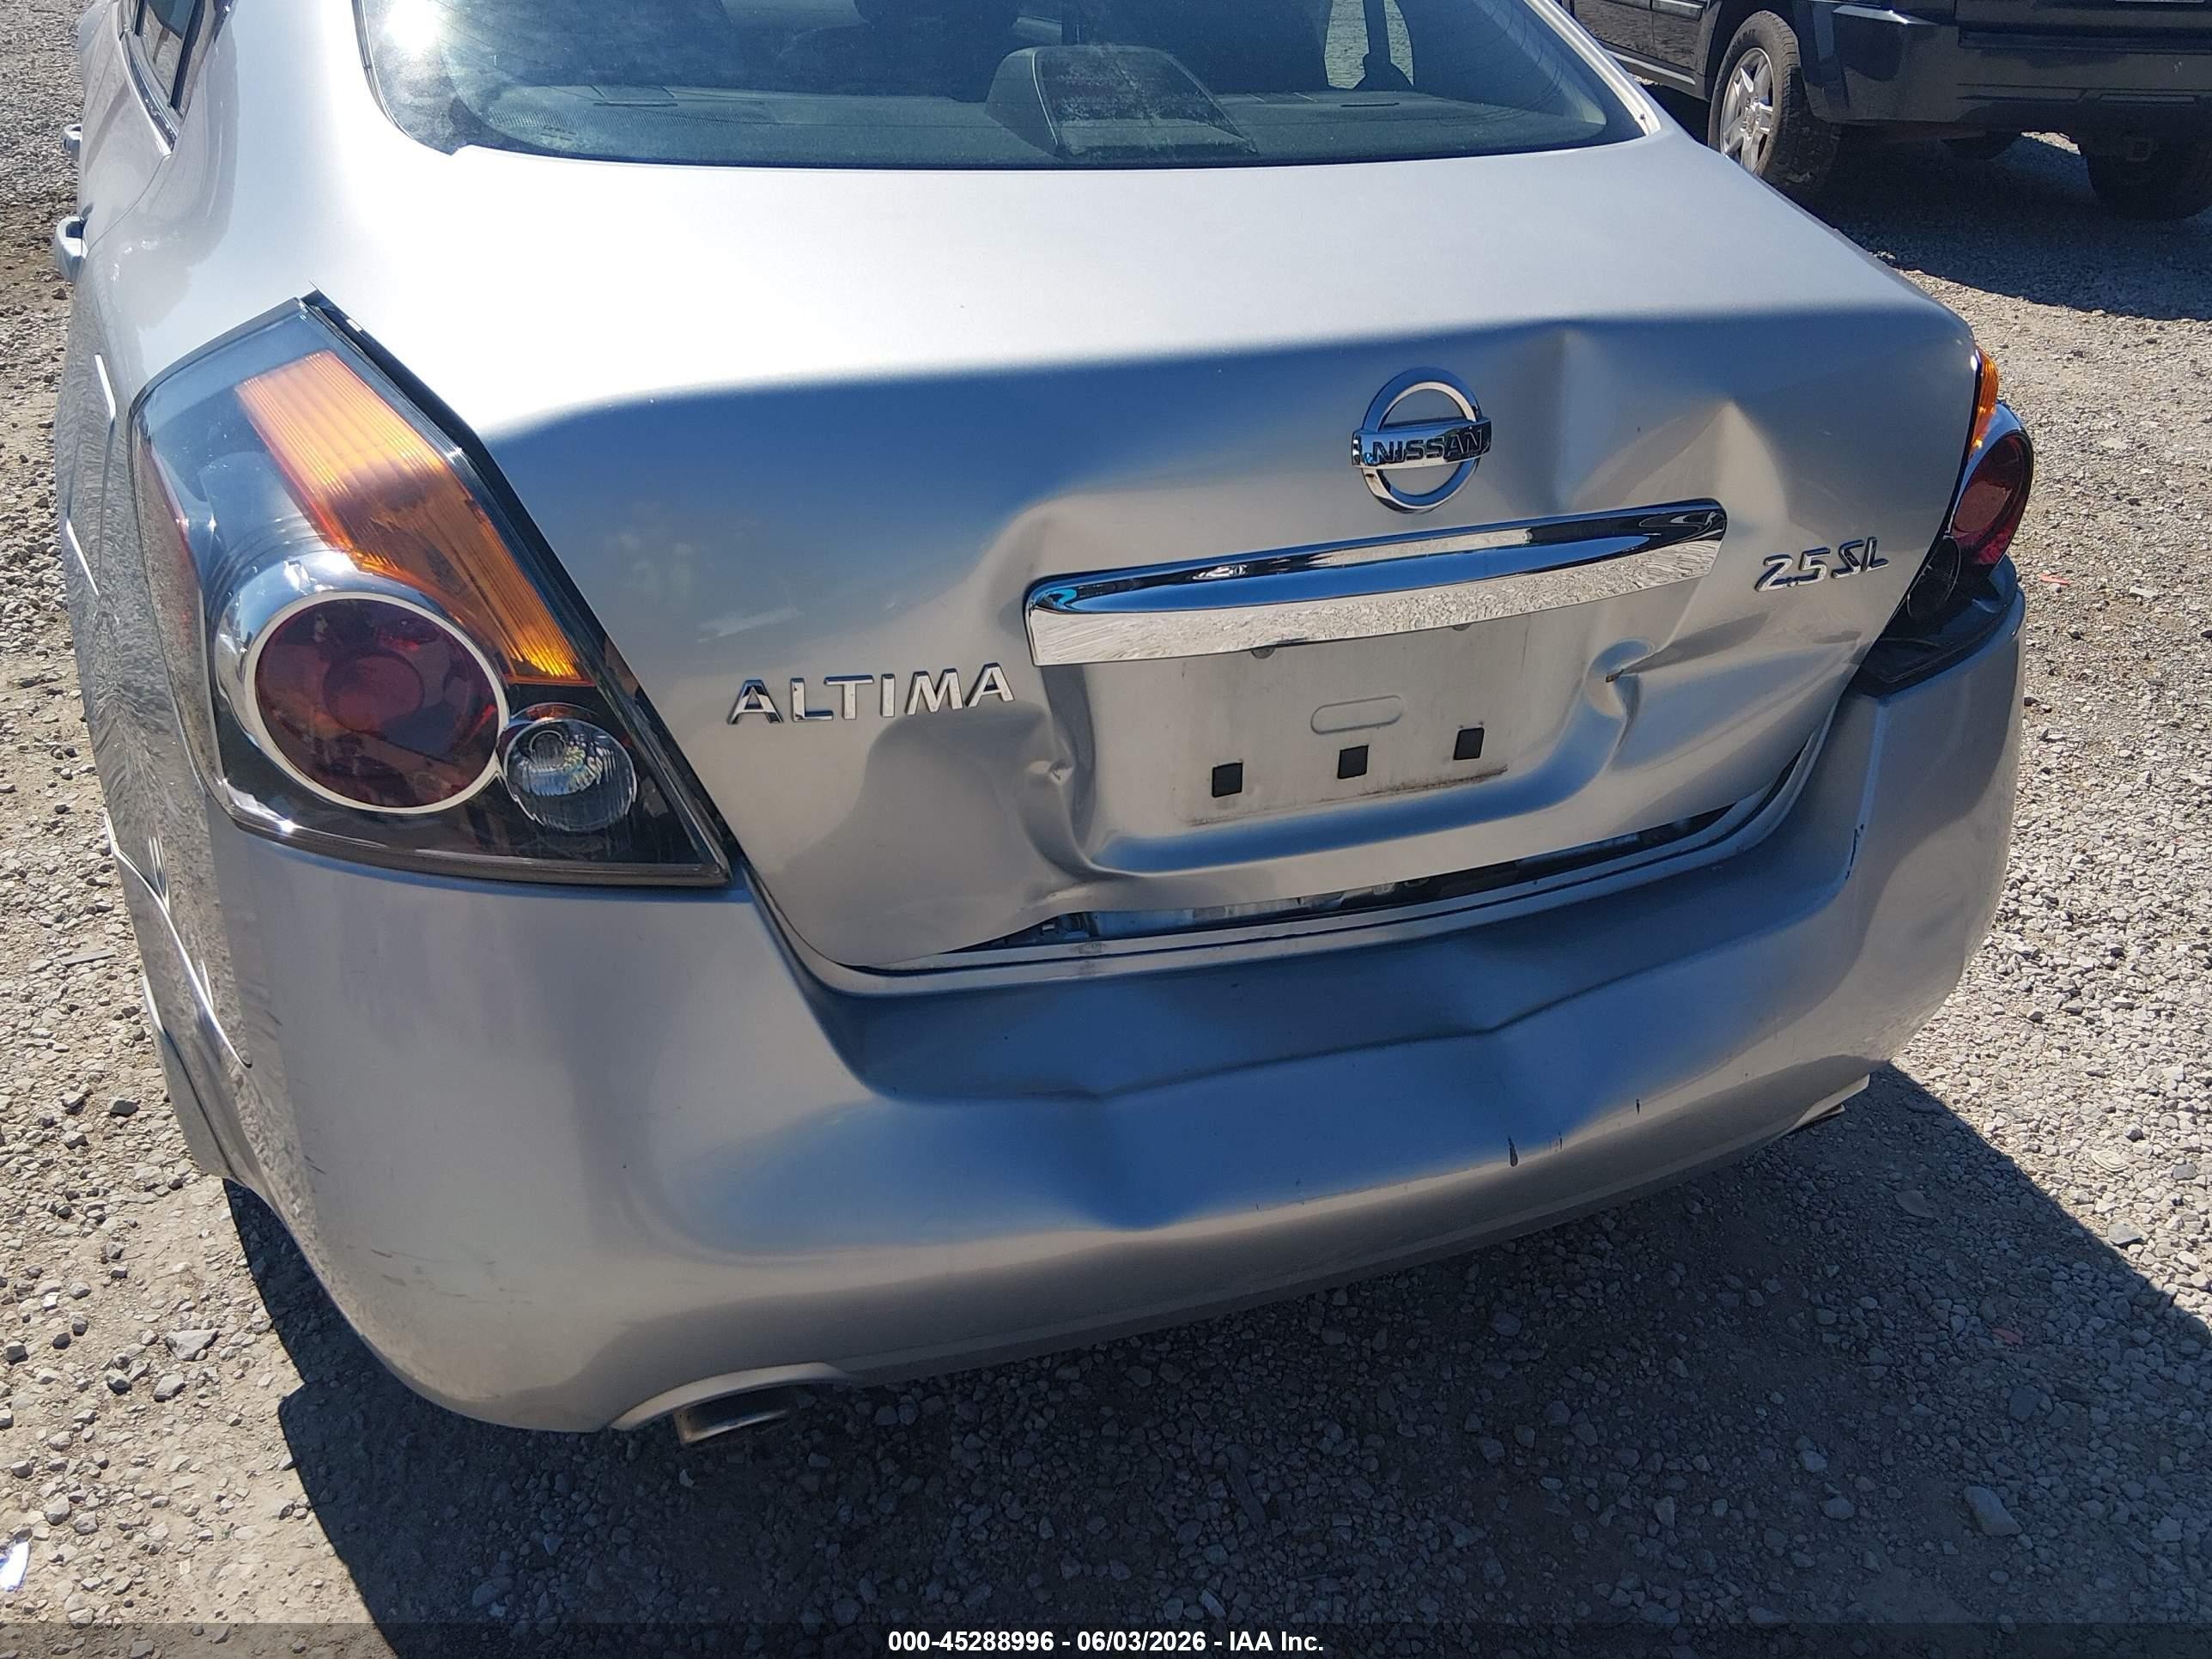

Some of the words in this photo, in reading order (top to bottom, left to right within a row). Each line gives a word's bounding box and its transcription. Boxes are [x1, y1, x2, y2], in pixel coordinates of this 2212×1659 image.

[1373, 429, 1483, 465] NISSAN
[1754, 546, 1831, 592] 2.5
[1831, 536, 1889, 579] SL
[727, 661, 1016, 725] ALTIMA
